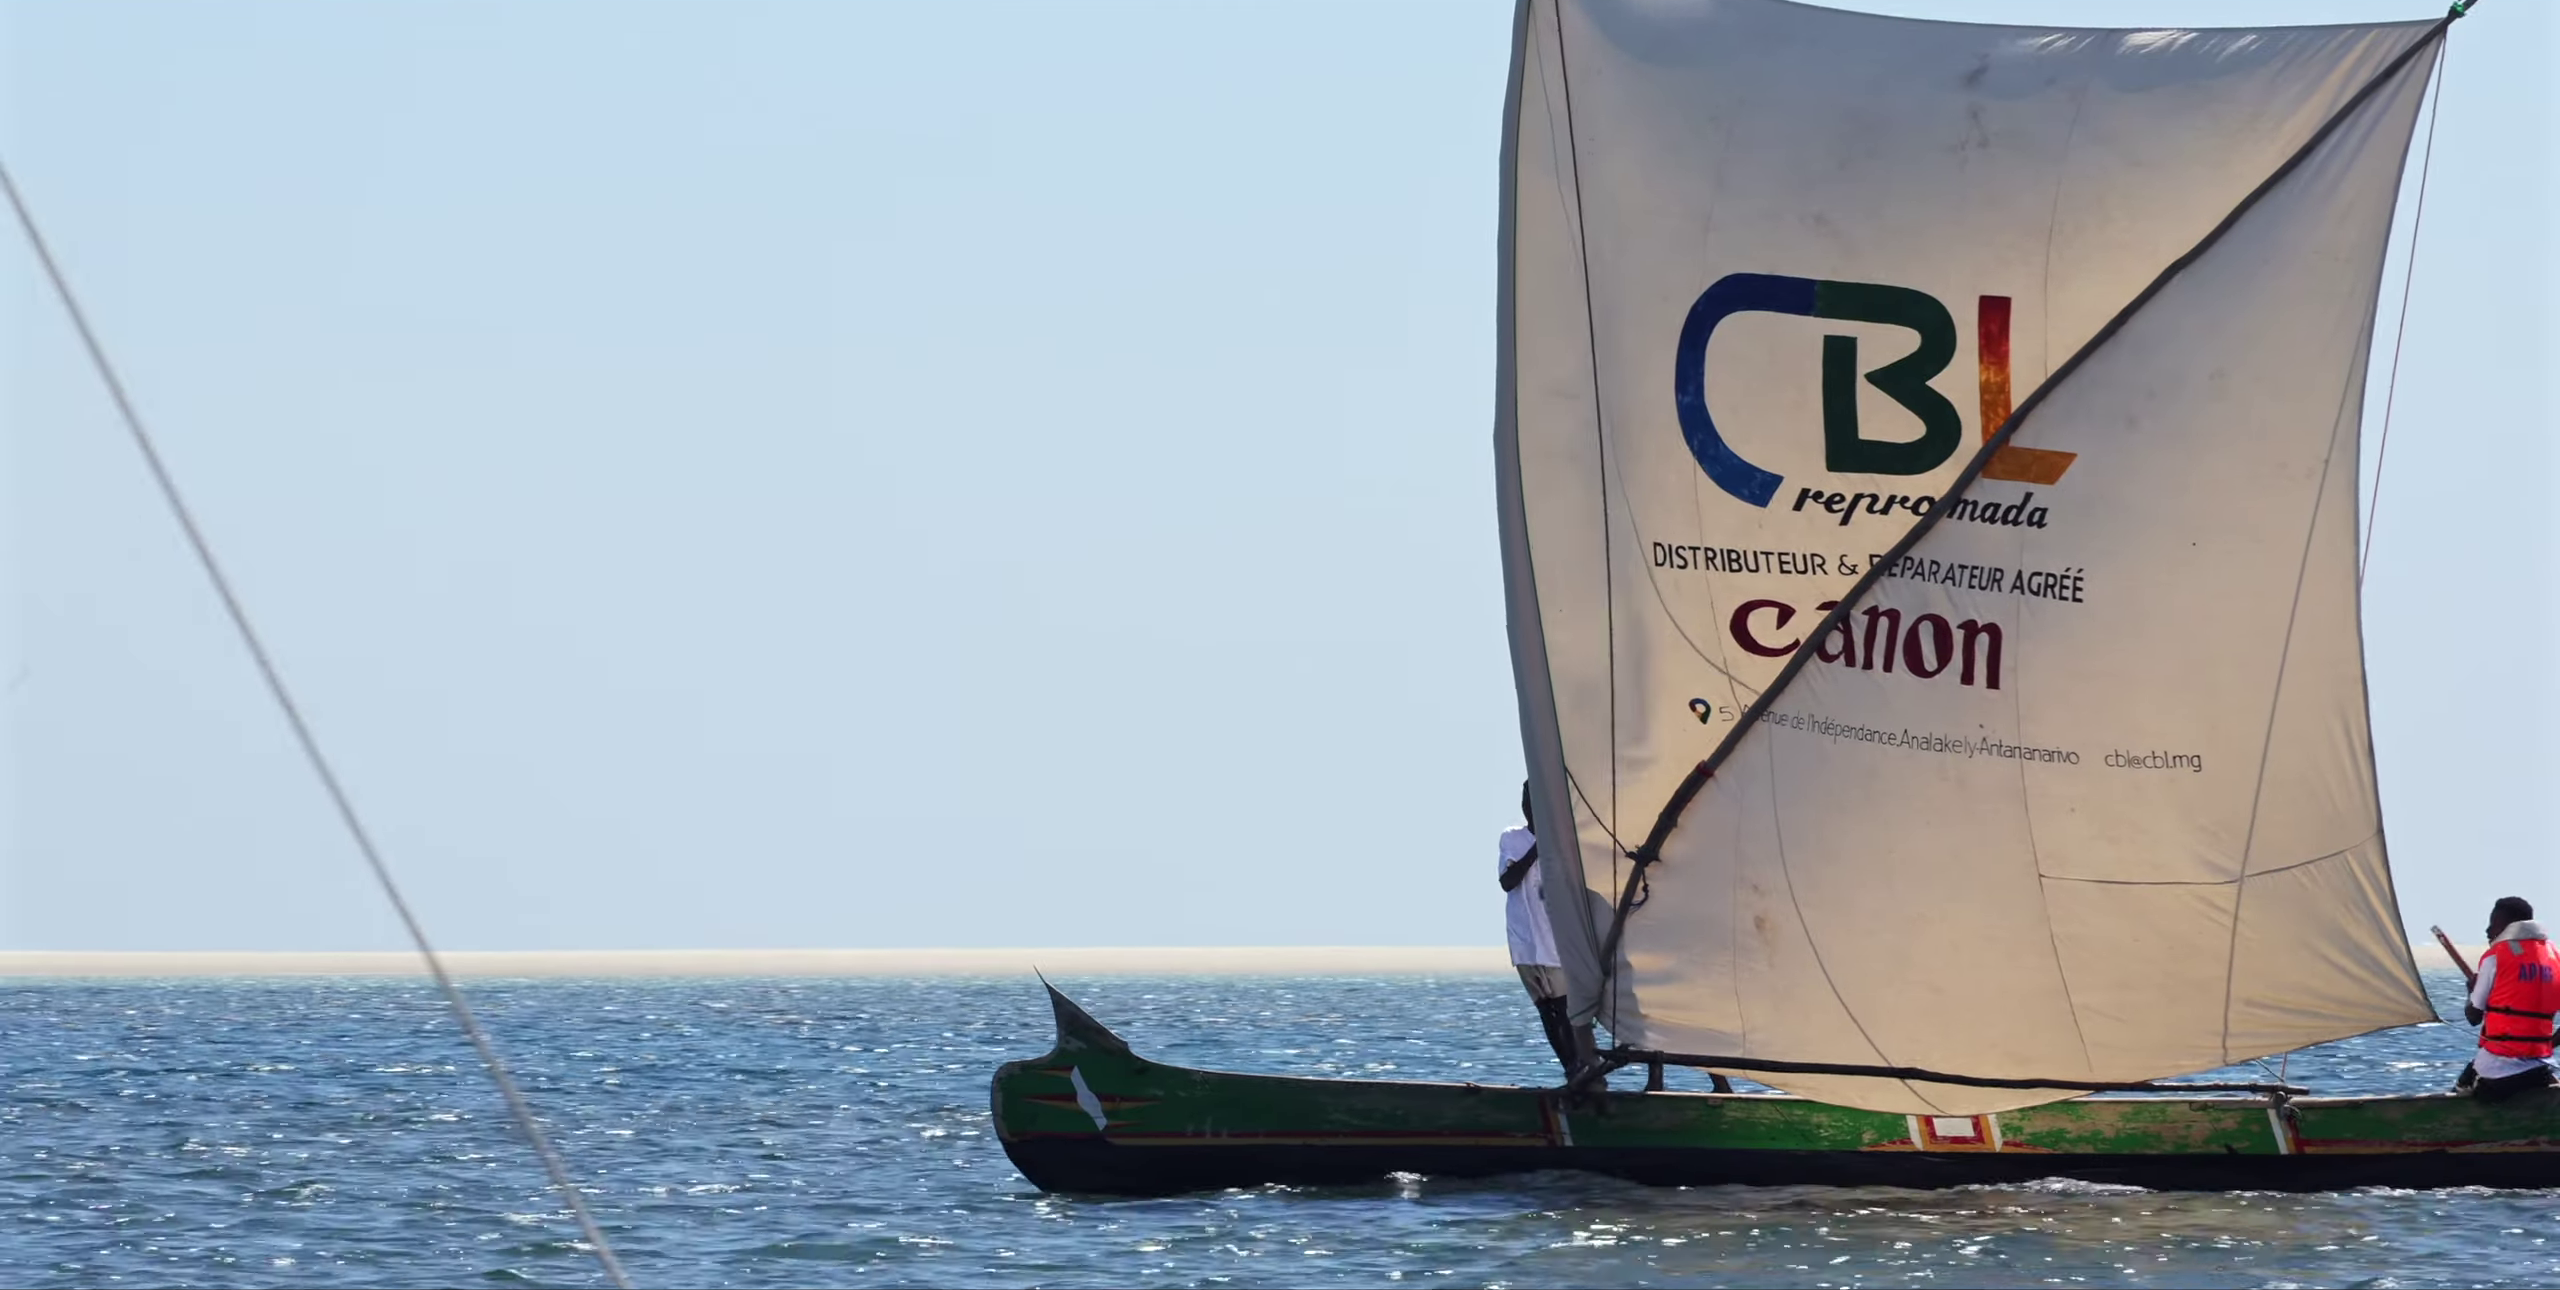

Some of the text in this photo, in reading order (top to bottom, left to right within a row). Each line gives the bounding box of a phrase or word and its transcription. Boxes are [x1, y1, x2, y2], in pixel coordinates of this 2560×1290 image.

[1675, 272, 2078, 508] CBL
[1653, 541, 1828, 576] DISTRIBUTEUR
[1837, 553, 1859, 576] &
[2009, 566, 2084, 604] AGRÉÉ
[1718, 705, 1735, 722] 5
[1791, 710, 1806, 731] de
[2104, 748, 2202, 773] cbl@cbl.mg
